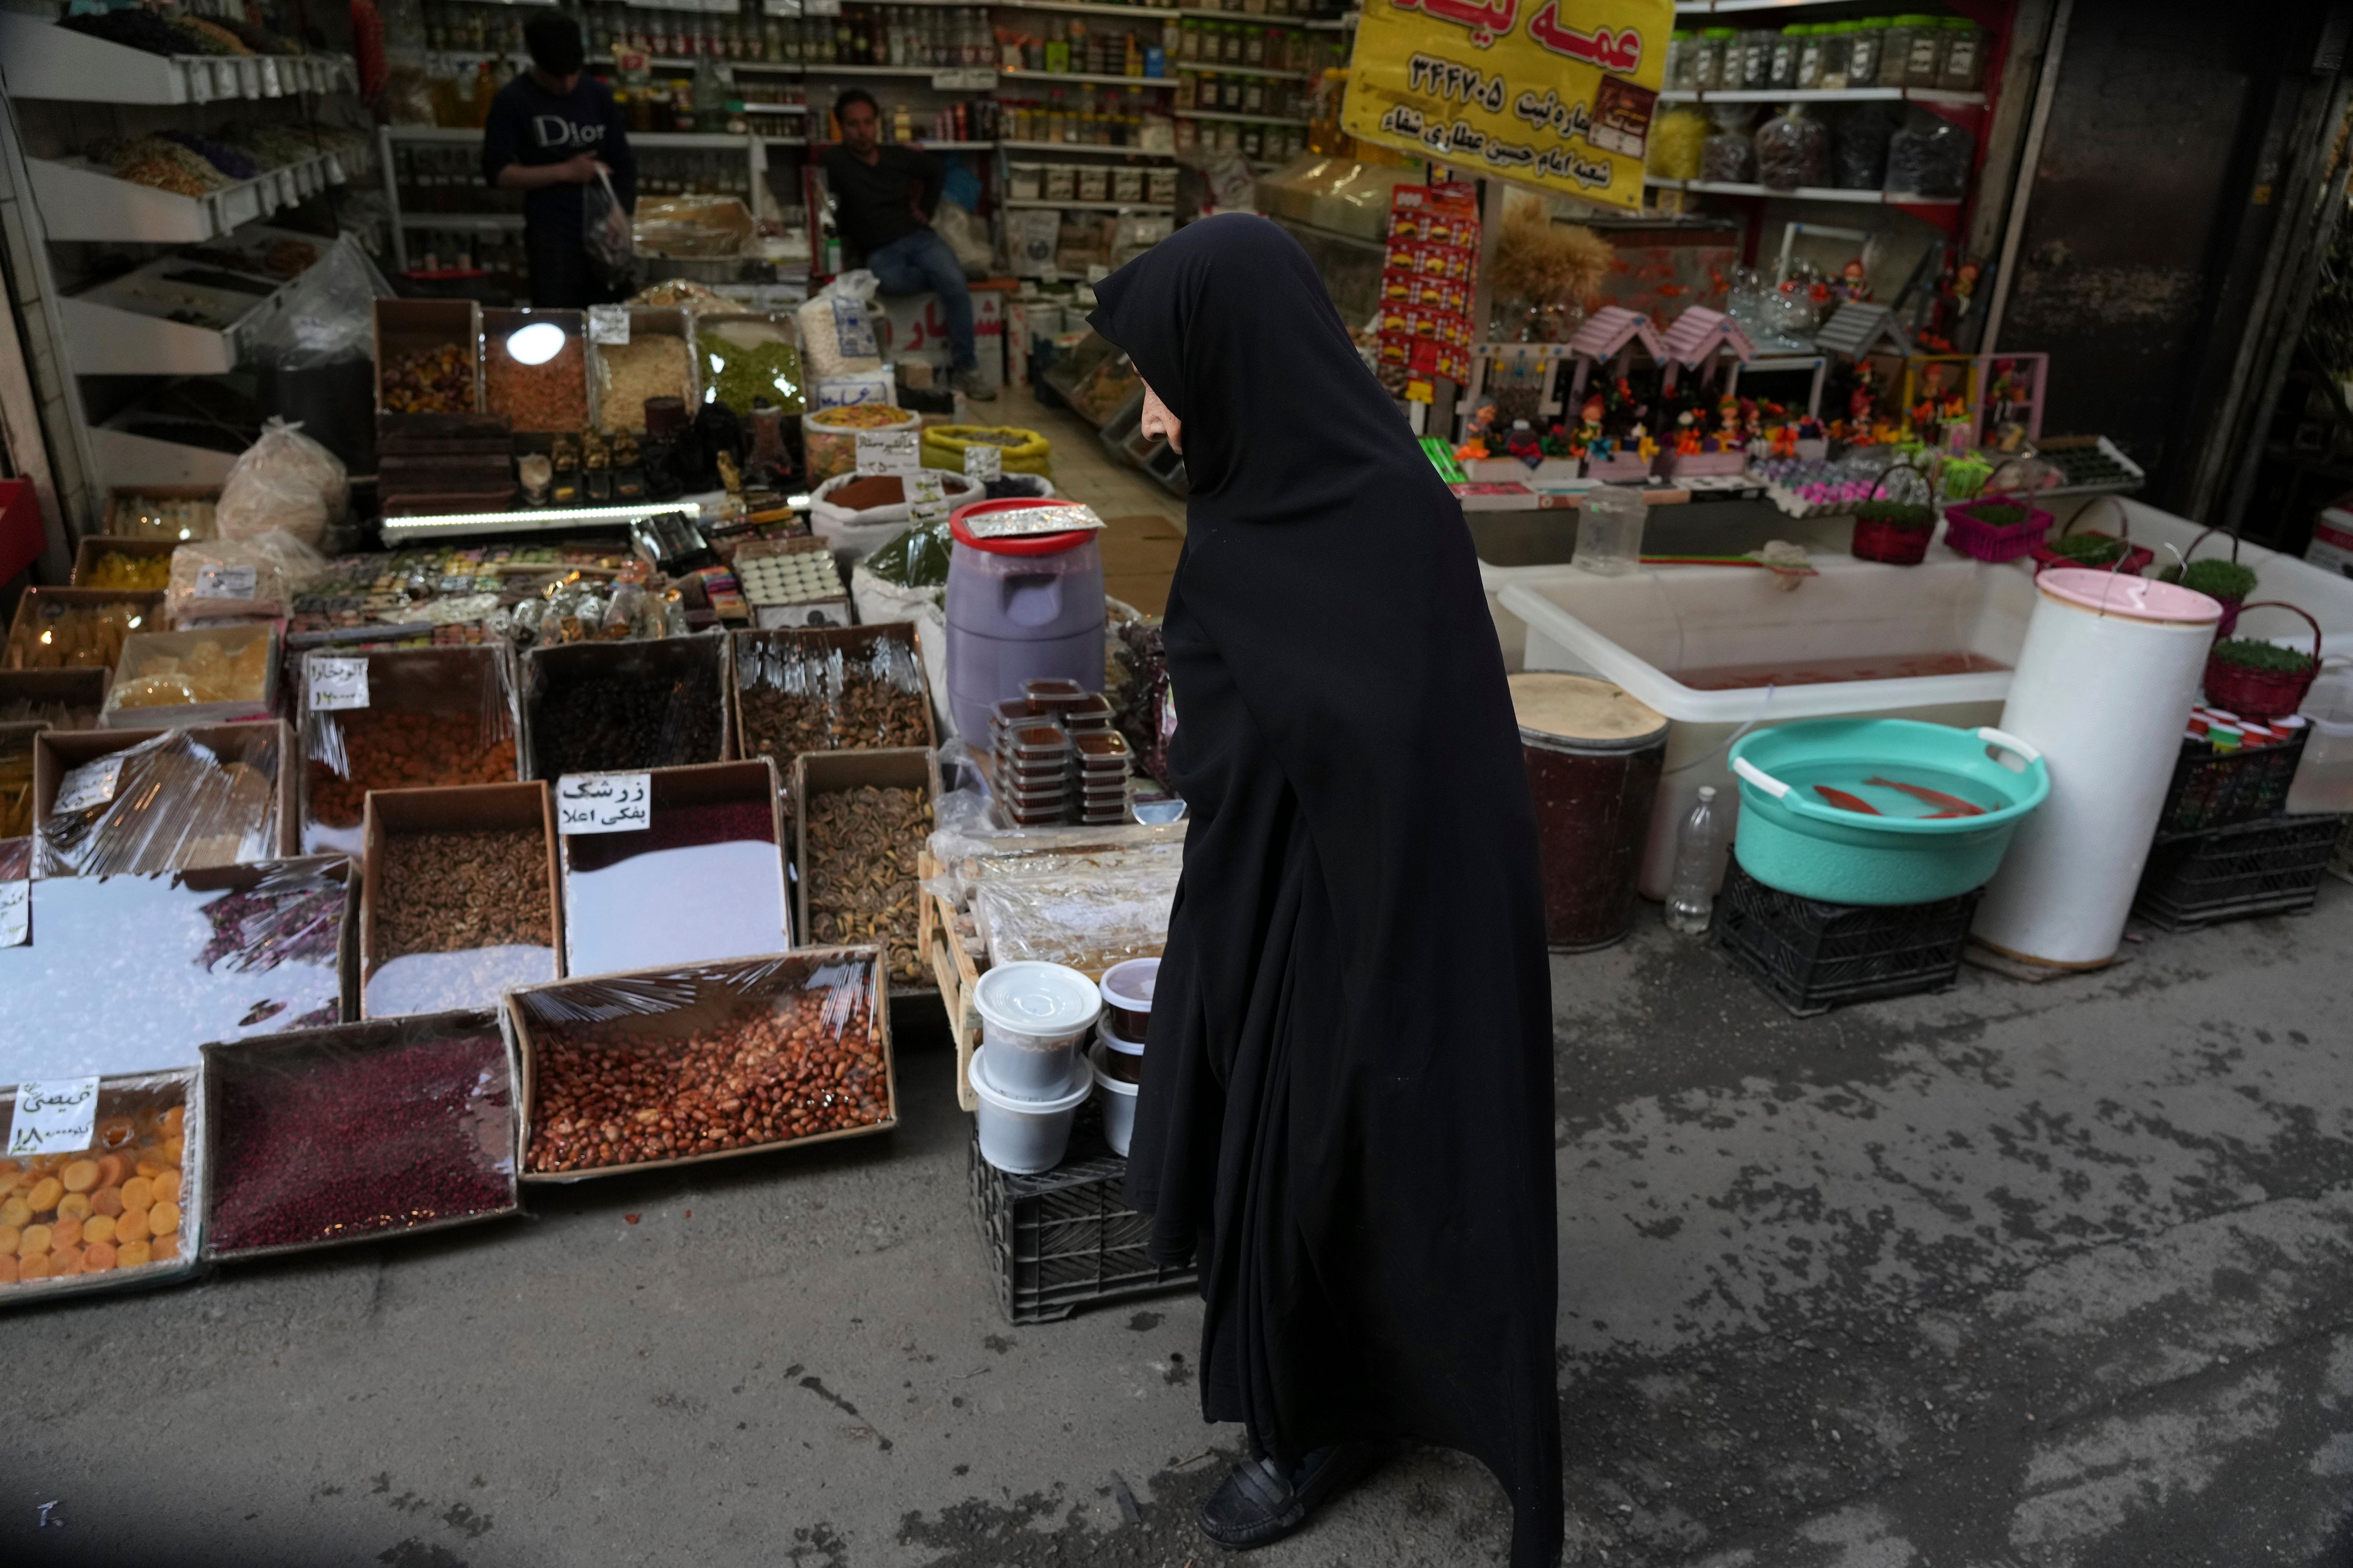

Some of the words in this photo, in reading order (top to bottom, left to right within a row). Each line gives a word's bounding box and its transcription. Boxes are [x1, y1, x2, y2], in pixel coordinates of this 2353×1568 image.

[1530, 3, 1641, 70] عمه
[1411, 56, 1502, 110] ۳۴۴۷۰۵
[1518, 95, 1554, 125] ثبت
[1554, 106, 1590, 134] ماره
[533, 114, 607, 147] Dior
[1424, 124, 1484, 149] عطاری
[1486, 141, 1533, 164] حسین
[1538, 149, 1572, 174] امام
[1573, 162, 1608, 185] شعبه
[563, 780, 645, 803] زرشک
[563, 809, 596, 824] اعلا
[601, 806, 646, 825] پفکی
[23, 1084, 94, 1113] قیصی
